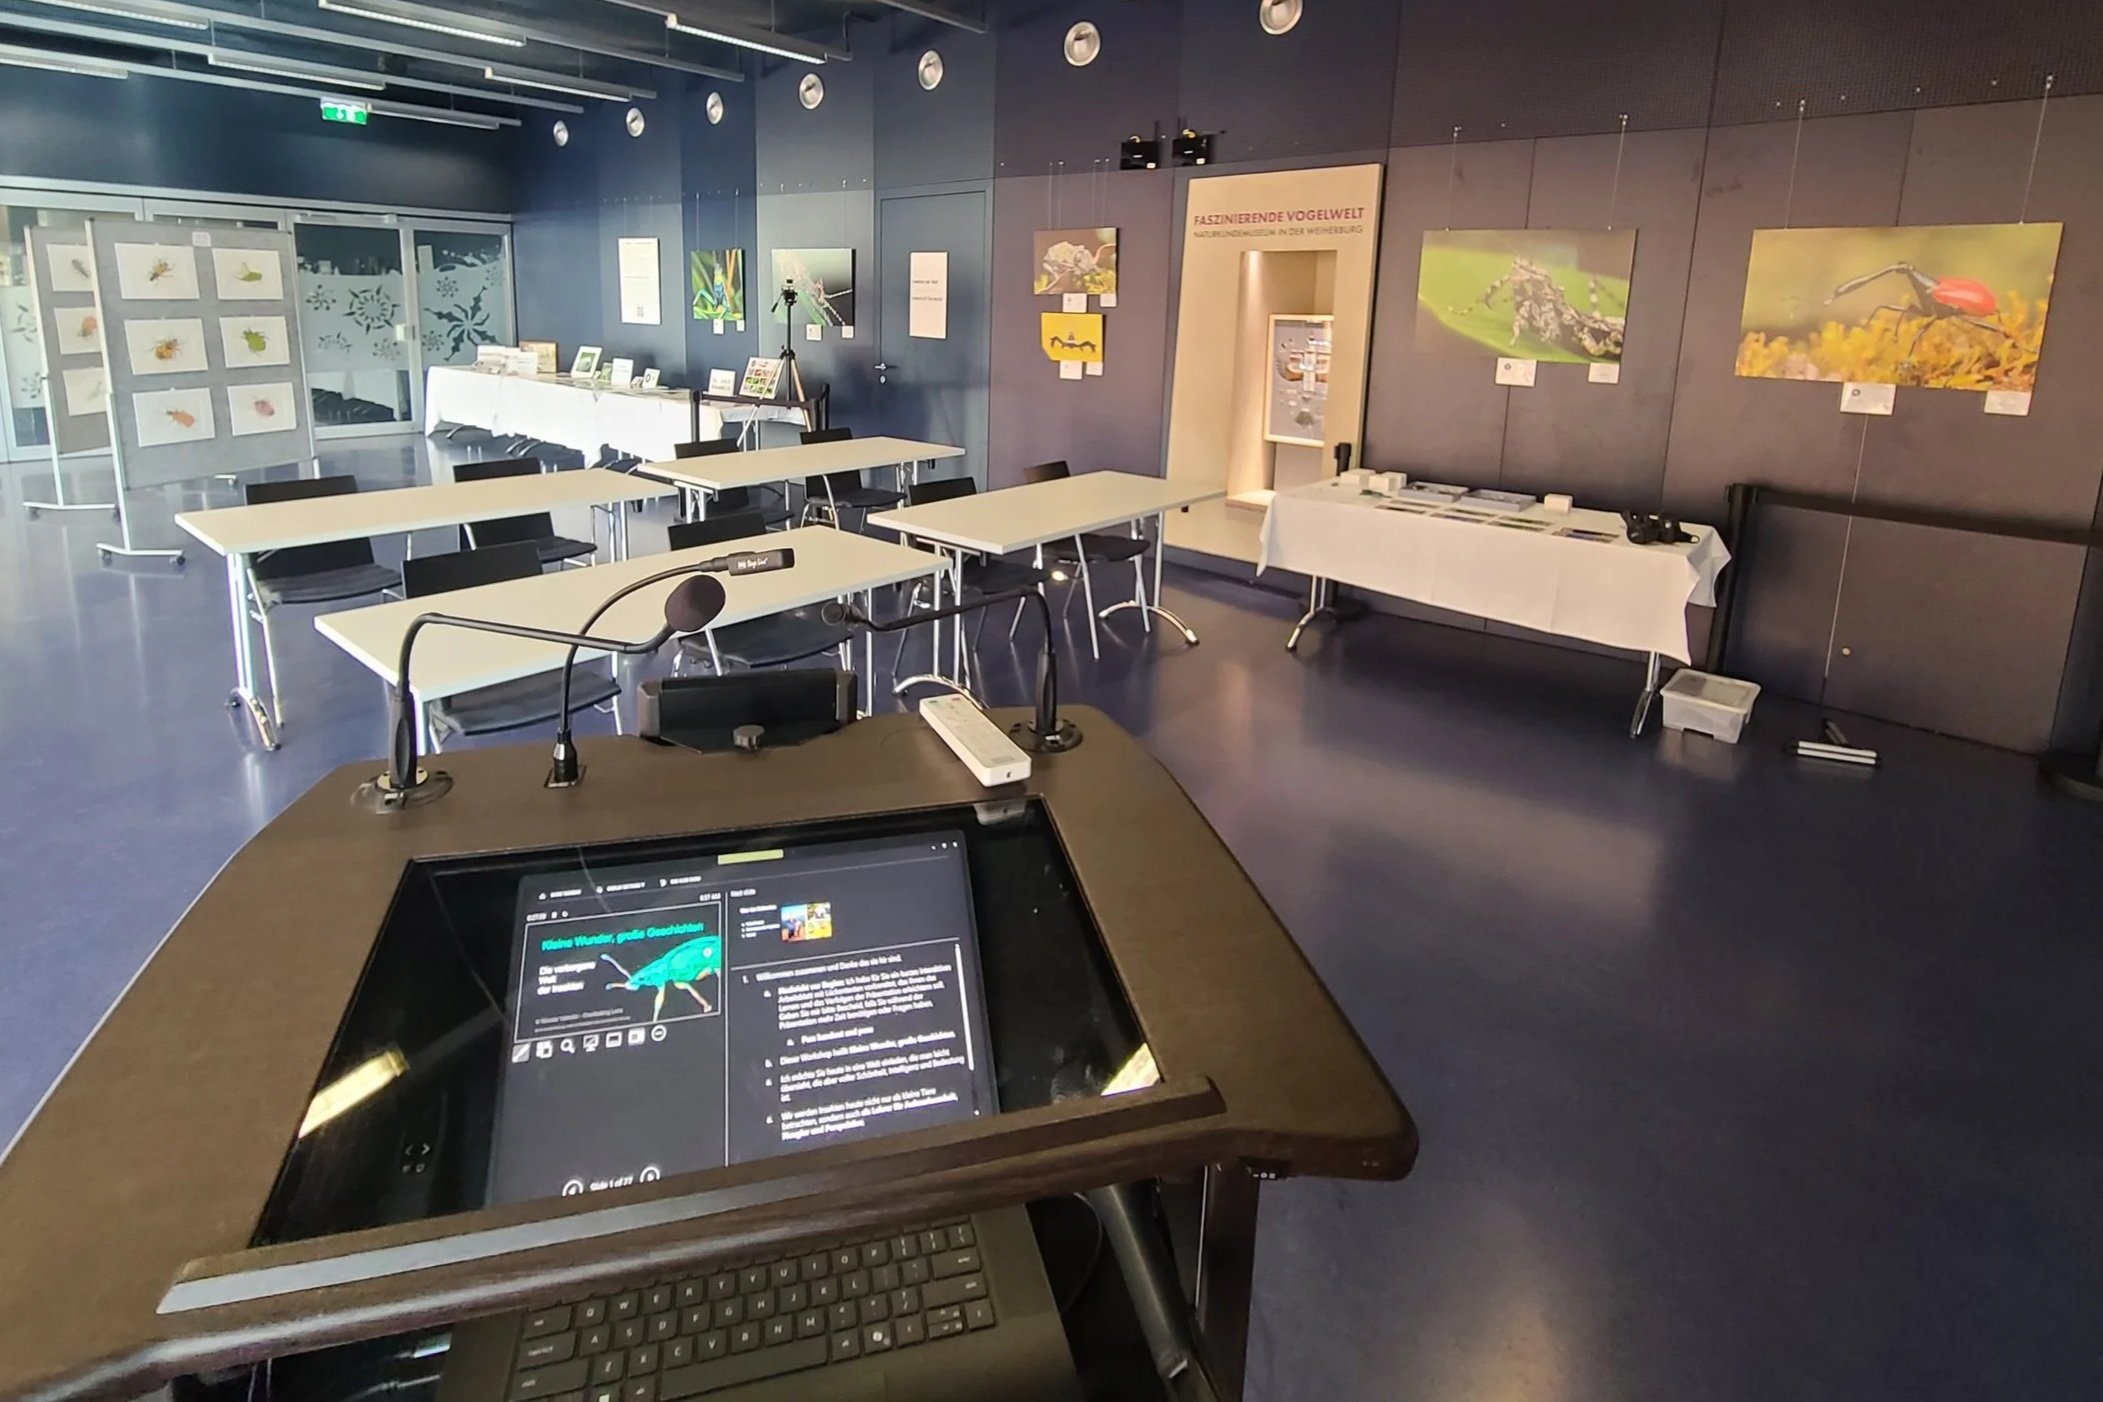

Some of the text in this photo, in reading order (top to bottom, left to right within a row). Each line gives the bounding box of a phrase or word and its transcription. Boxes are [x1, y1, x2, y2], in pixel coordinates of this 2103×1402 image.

[1194, 207, 1364, 226] FASZINIERENDE VOGELWELT
[1289, 227, 1304, 236] DER
[542, 922, 704, 950] Kleine Wunder, große Geschichten
